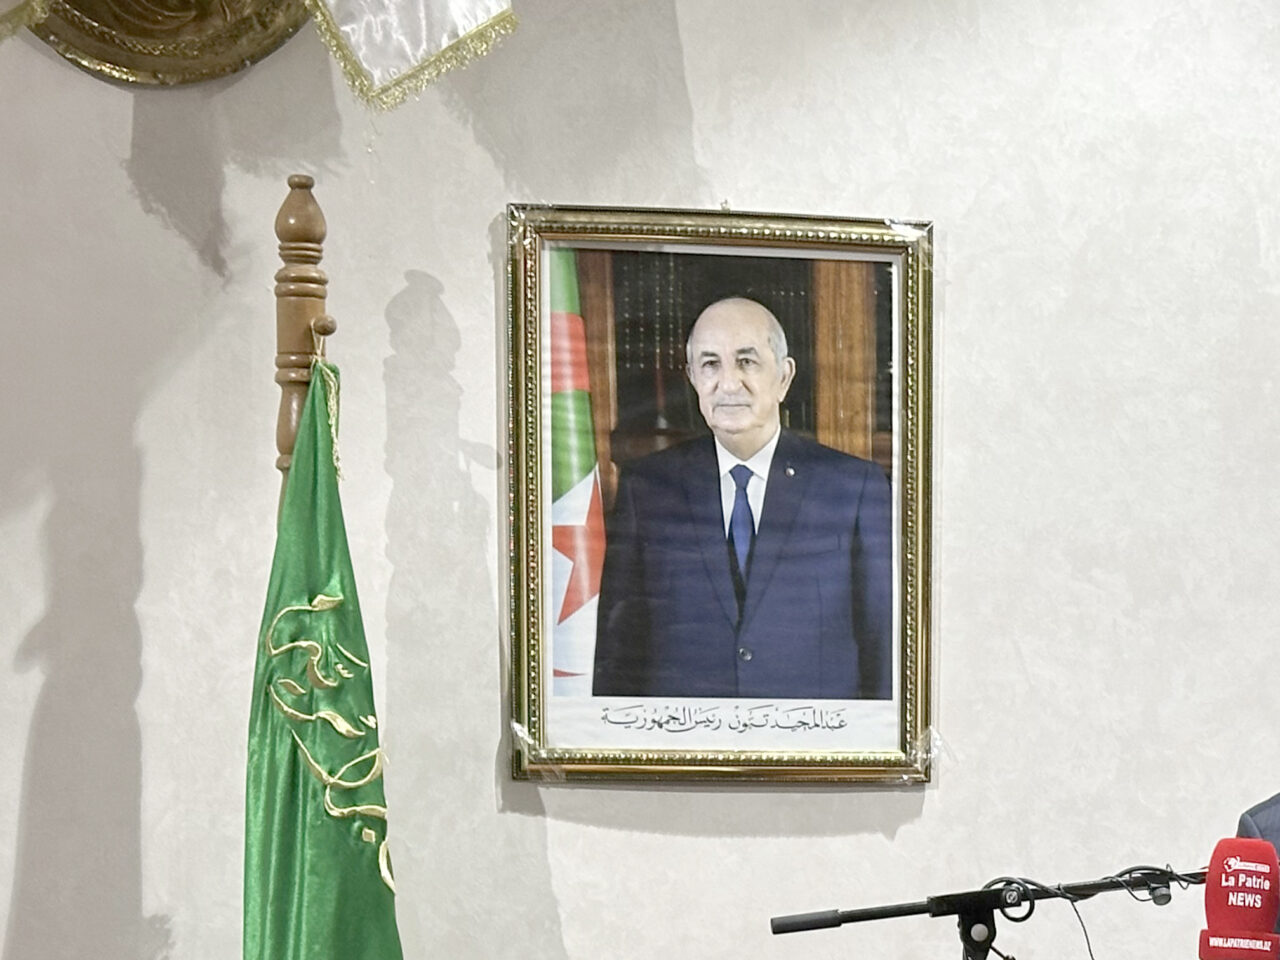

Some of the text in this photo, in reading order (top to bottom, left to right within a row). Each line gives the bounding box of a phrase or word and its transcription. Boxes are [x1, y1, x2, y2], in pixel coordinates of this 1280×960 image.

[601, 703, 693, 731] الجمهورية
[728, 703, 775, 733] تبون
[1221, 873, 1271, 890] La Patrie
[1227, 891, 1263, 908] NEWS
